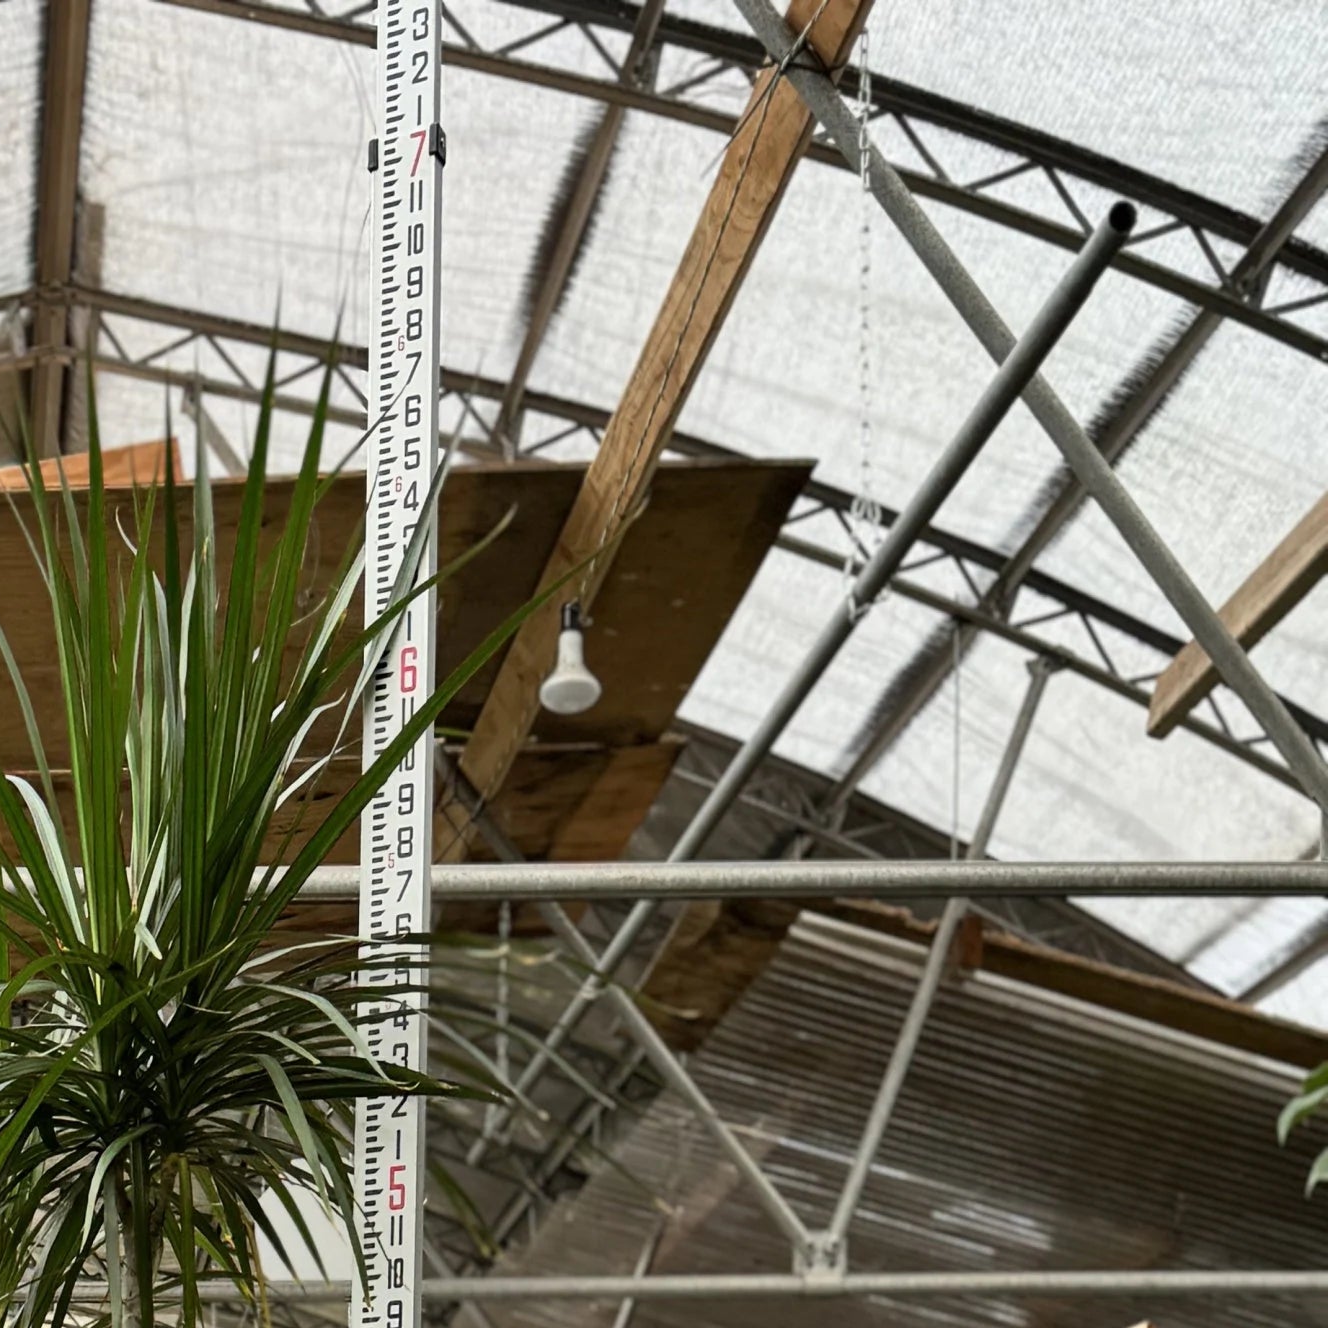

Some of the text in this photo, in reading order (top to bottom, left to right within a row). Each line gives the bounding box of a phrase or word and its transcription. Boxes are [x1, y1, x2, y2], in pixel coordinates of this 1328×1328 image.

[413, 7, 429, 41] 3
[412, 51, 428, 84] 2
[410, 130, 426, 177] 7
[410, 180, 422, 213] 11
[408, 223, 424, 256] 10
[407, 266, 423, 299] 9
[407, 309, 422, 341] 8
[406, 351, 422, 386] 7
[405, 395, 421, 427] 6
[404, 437, 420, 470] 5
[403, 481, 419, 511] 4
[400, 646, 417, 693] 6
[398, 783, 414, 815] 9
[398, 826, 413, 858] 8
[397, 870, 412, 902] 7
[389, 1165, 406, 1211] 5
[390, 1215, 403, 1246] 11
[387, 1258, 404, 1289] 10
